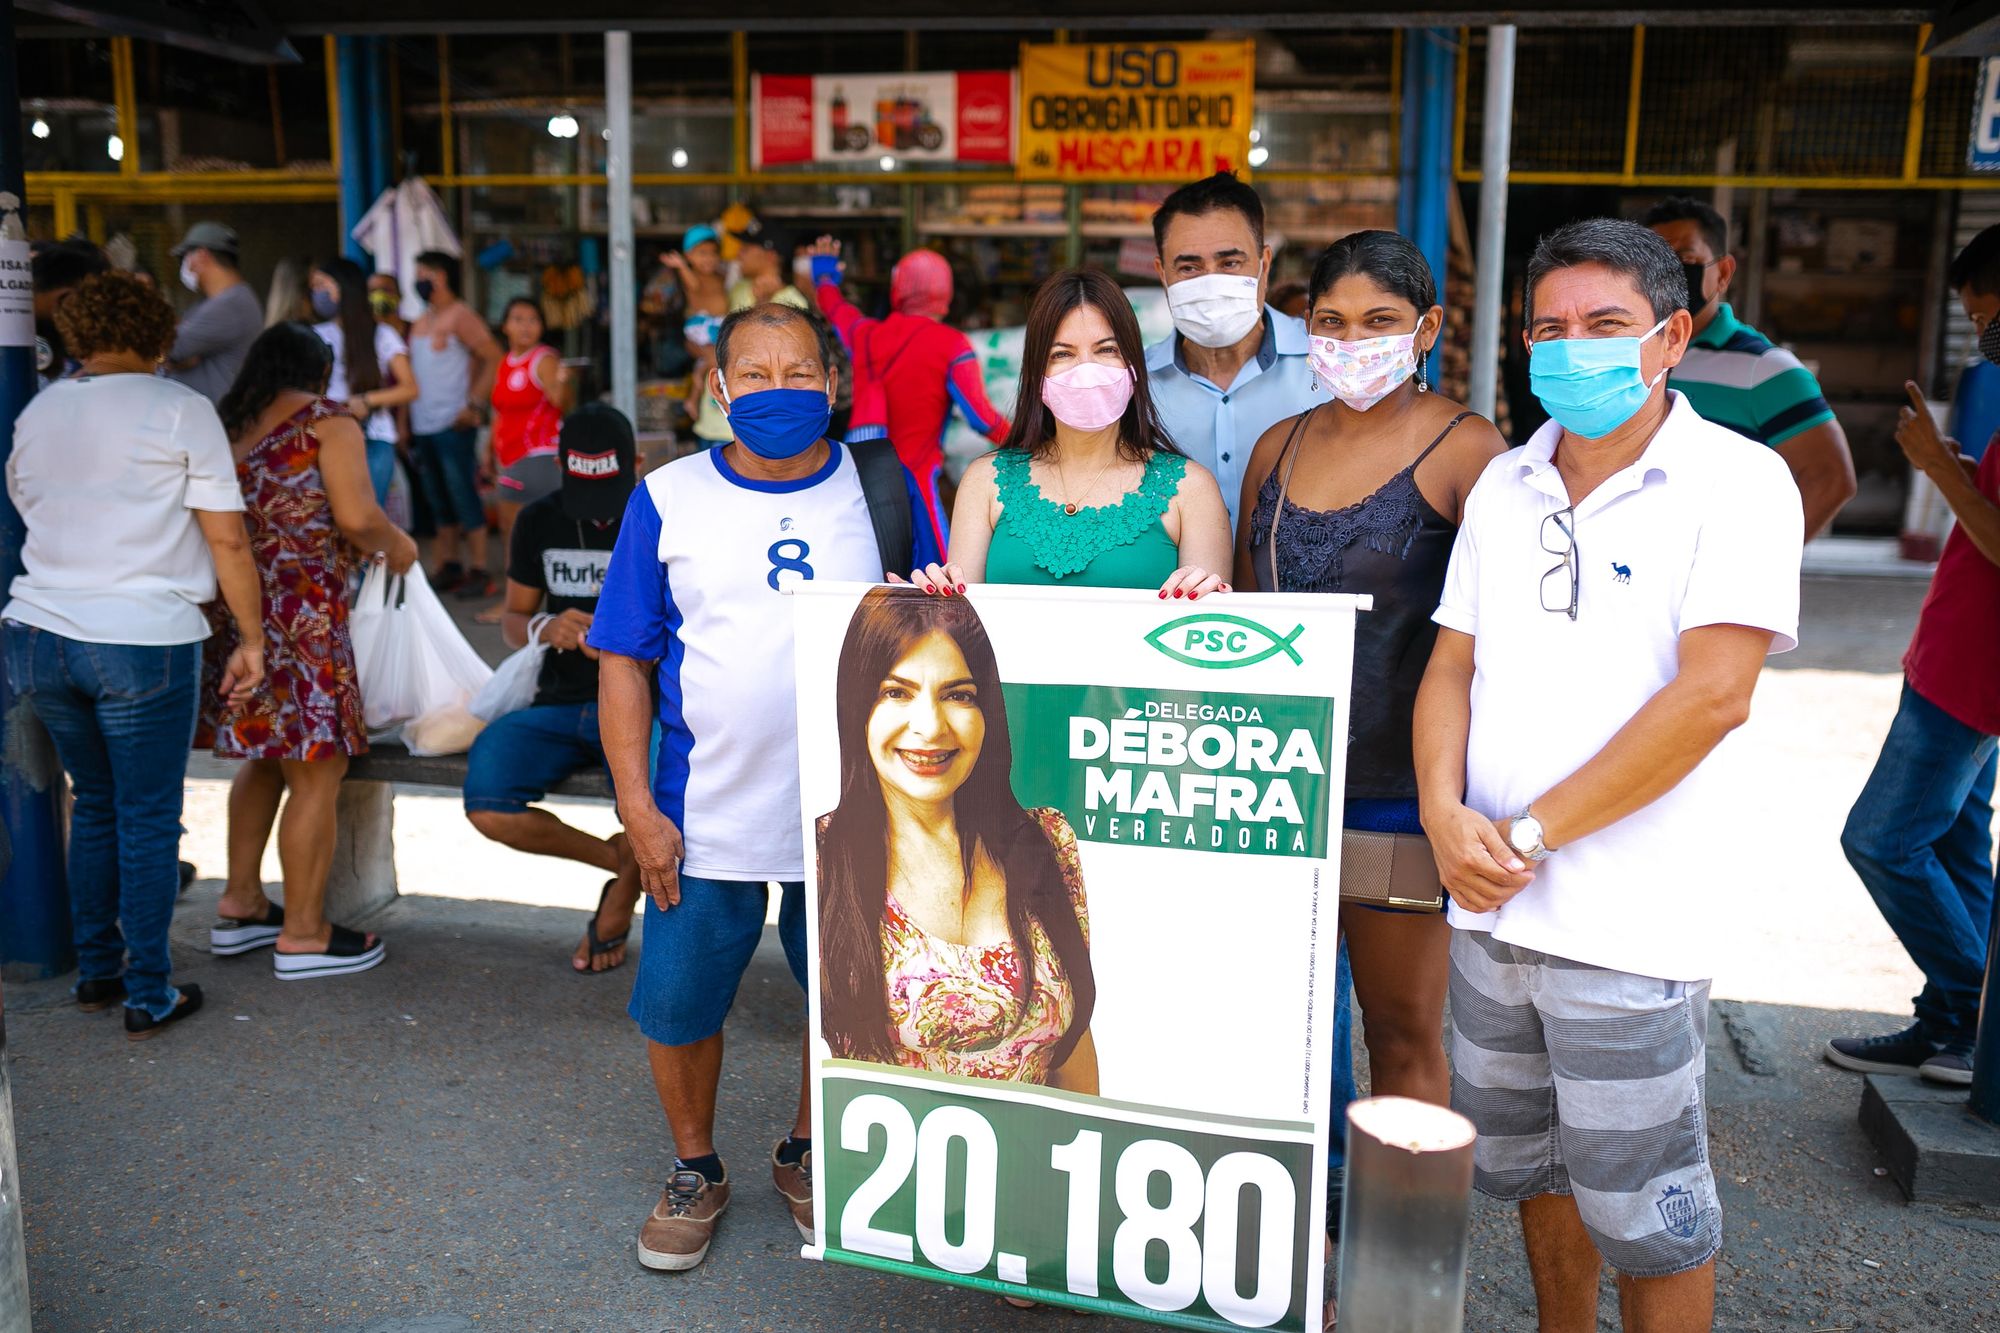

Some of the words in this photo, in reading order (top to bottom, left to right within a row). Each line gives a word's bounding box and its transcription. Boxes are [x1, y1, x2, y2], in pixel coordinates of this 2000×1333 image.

[1088, 48, 1180, 88] USO
[1030, 94, 1234, 131] OBRIGATORIO
[1056, 138, 1206, 174] MASCARA
[568, 454, 620, 475] CAIPIRA
[767, 538, 814, 591] 8
[1184, 629, 1248, 653] PSC
[1144, 701, 1264, 723] DELEGADA
[1068, 707, 1326, 775] DÉBORA
[1084, 765, 1305, 825] MAFRA
[1084, 814, 1305, 852] VEREADORA
[840, 1093, 1296, 1329] 20.180
